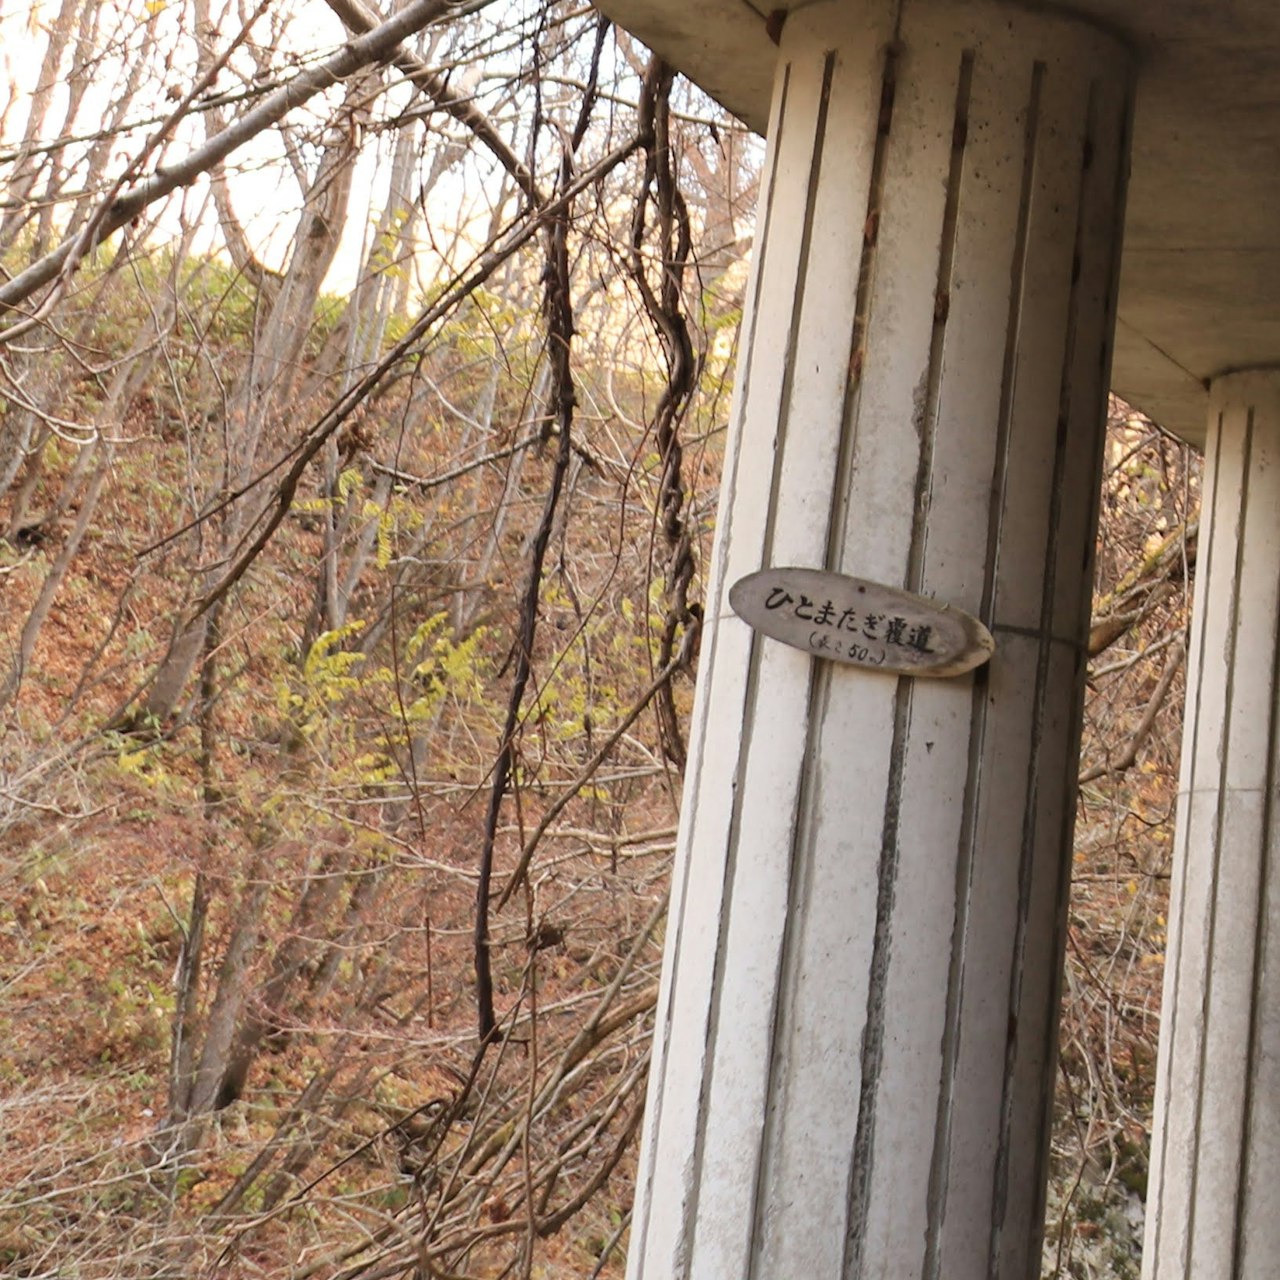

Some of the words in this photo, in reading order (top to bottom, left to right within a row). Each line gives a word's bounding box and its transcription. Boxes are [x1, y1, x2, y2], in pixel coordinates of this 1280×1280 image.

[765, 587, 935, 654] ひとまたぎ覆道
